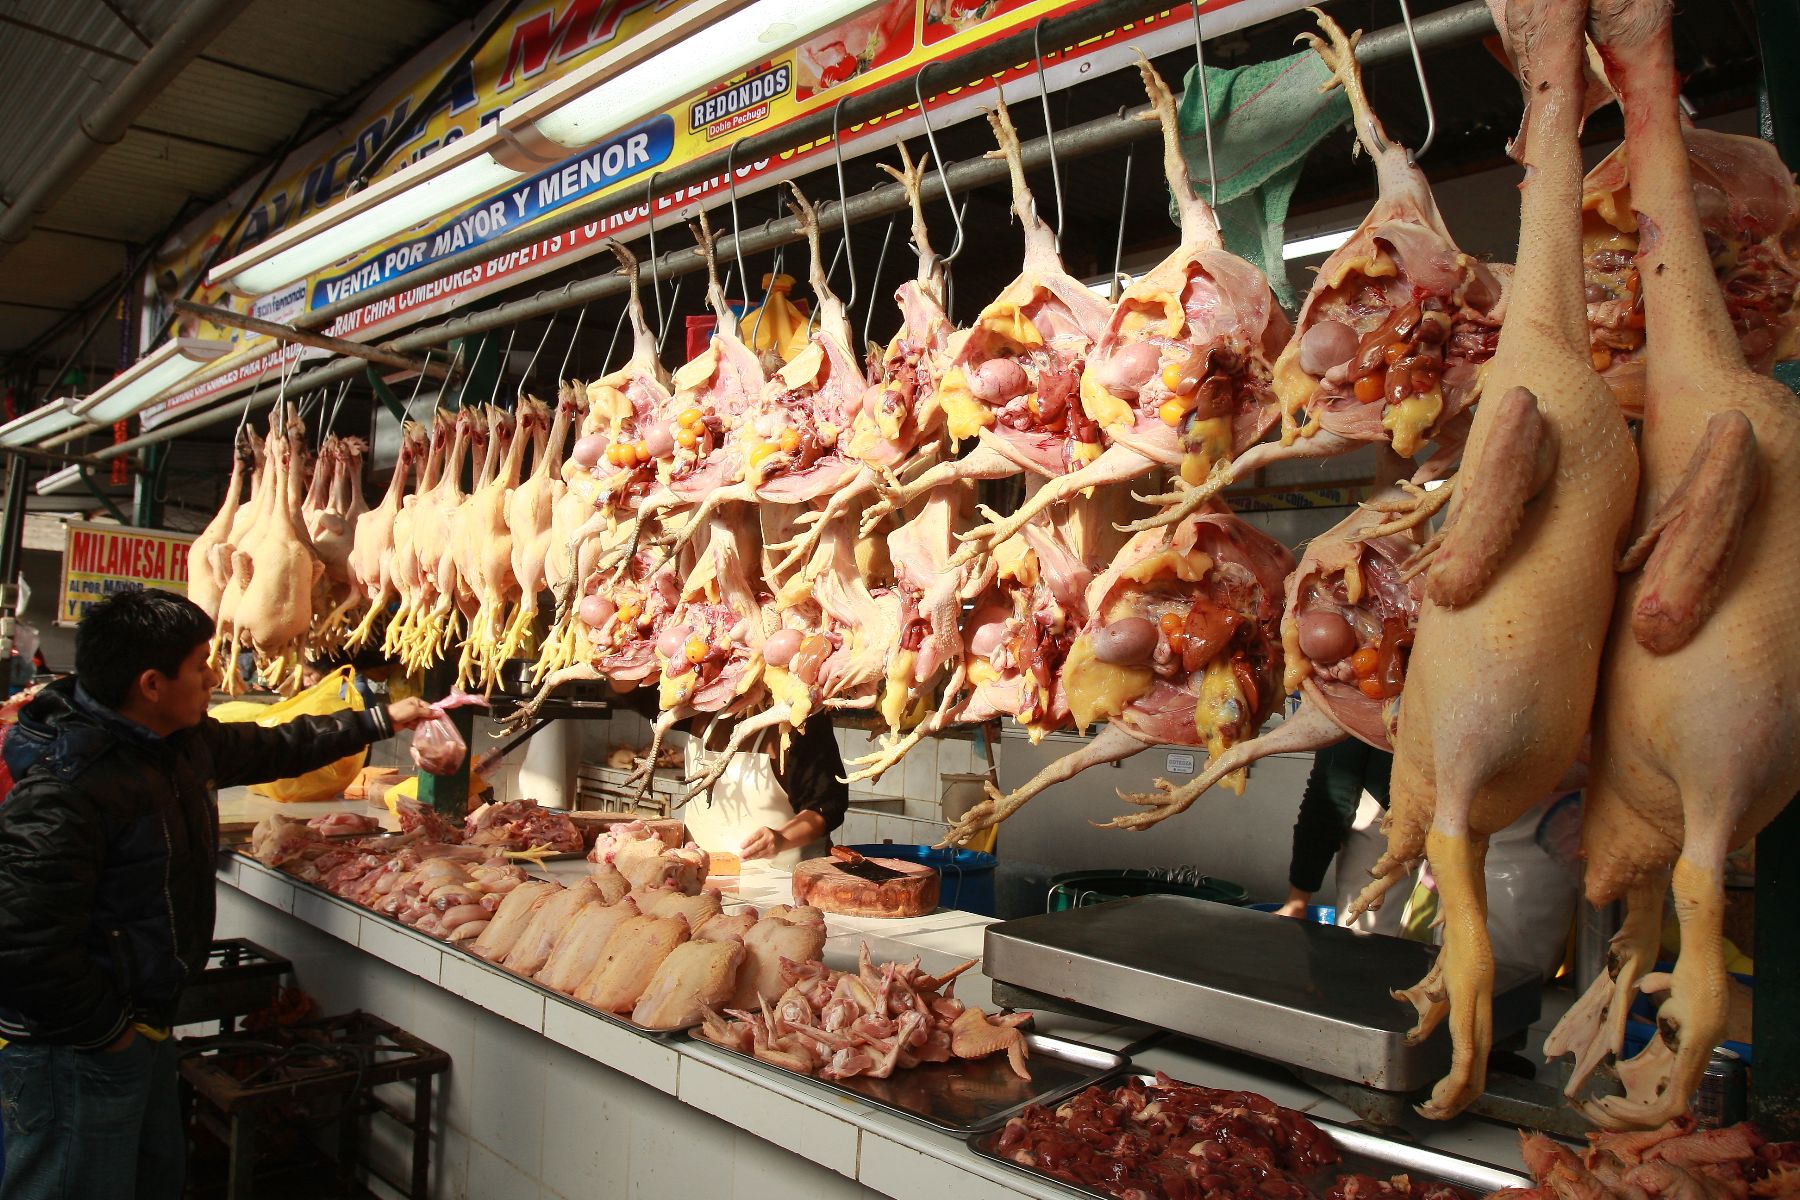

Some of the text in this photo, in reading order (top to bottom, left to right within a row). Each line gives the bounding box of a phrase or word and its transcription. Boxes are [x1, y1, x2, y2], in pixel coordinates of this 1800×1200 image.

[694, 69, 787, 128] REDONDOS
[709, 106, 766, 136] Doble Pechuga
[326, 260, 380, 303] VENTA
[384, 241, 427, 277] POR
[430, 200, 507, 258] MAYOR
[512, 186, 532, 218] Y
[538, 132, 650, 208] MENOR
[71, 531, 166, 580] MILANESA
[82, 580, 100, 594] POR
[68, 599, 77, 616] Y
